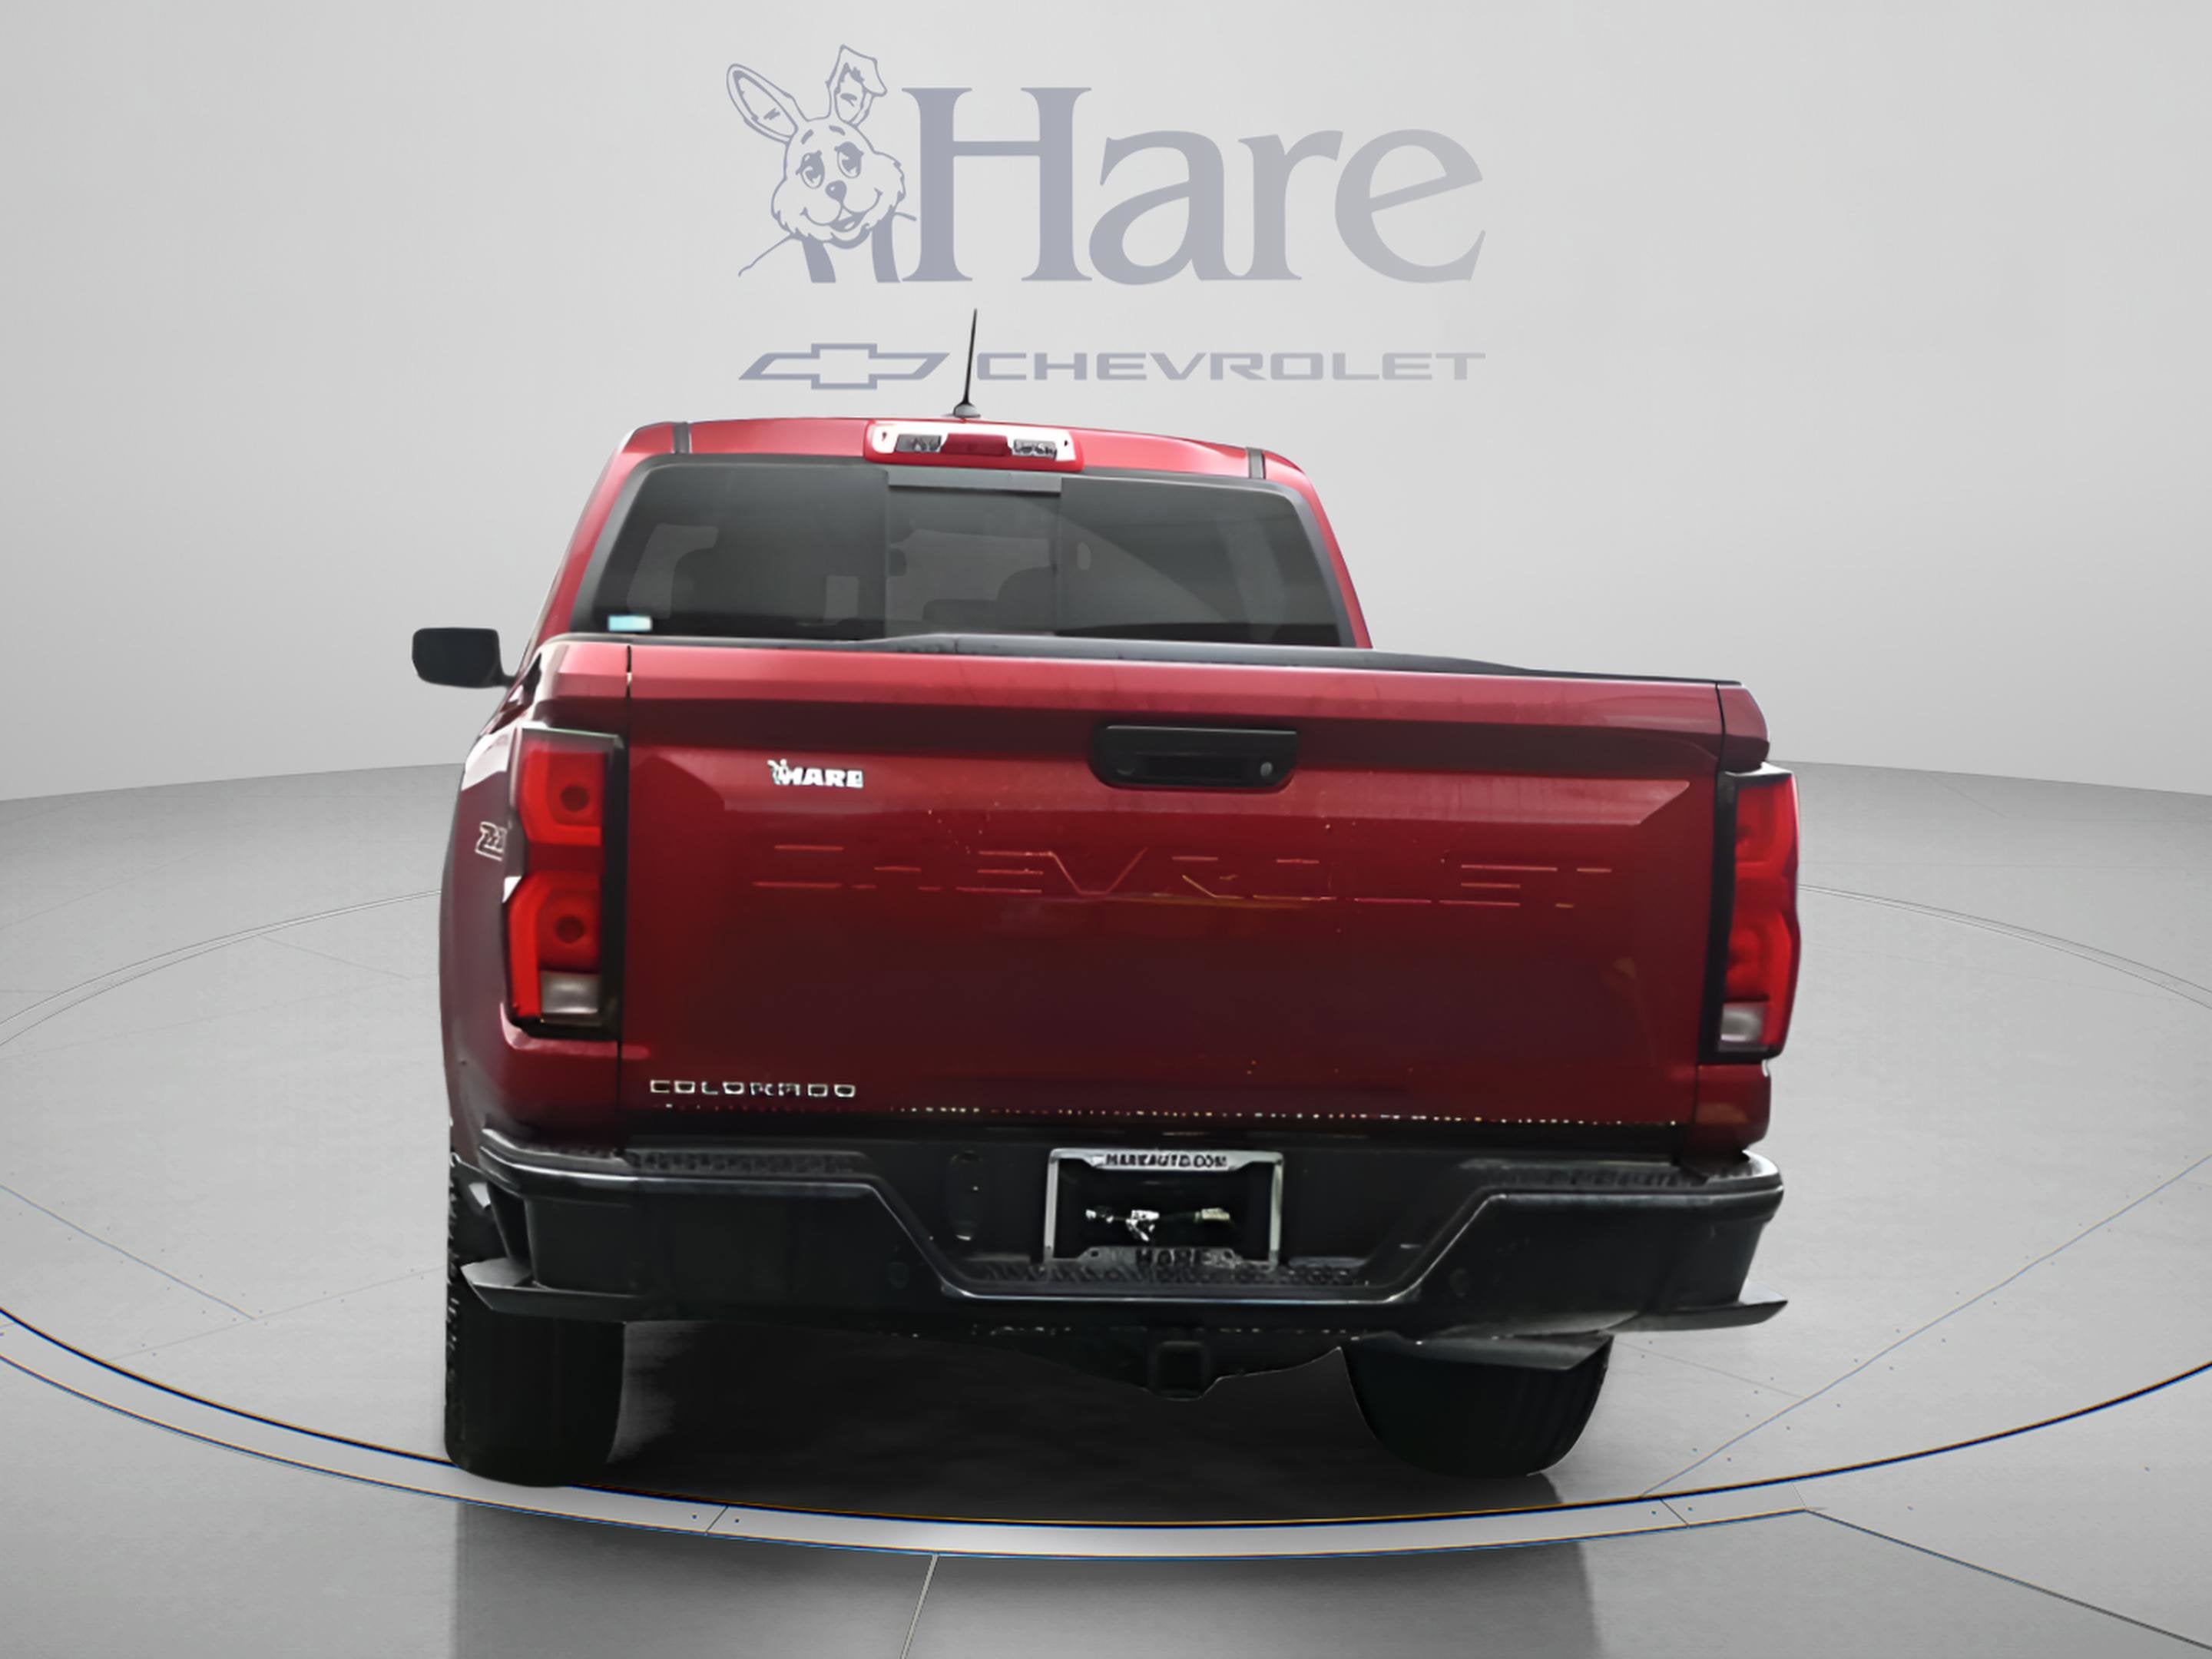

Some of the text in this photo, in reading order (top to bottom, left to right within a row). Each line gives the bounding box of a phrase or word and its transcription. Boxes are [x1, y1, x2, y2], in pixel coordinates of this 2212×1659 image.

[901, 86, 1486, 286] Hare
[976, 351, 1486, 381] CHEVROLET
[649, 1079, 856, 1098] COLORADO
